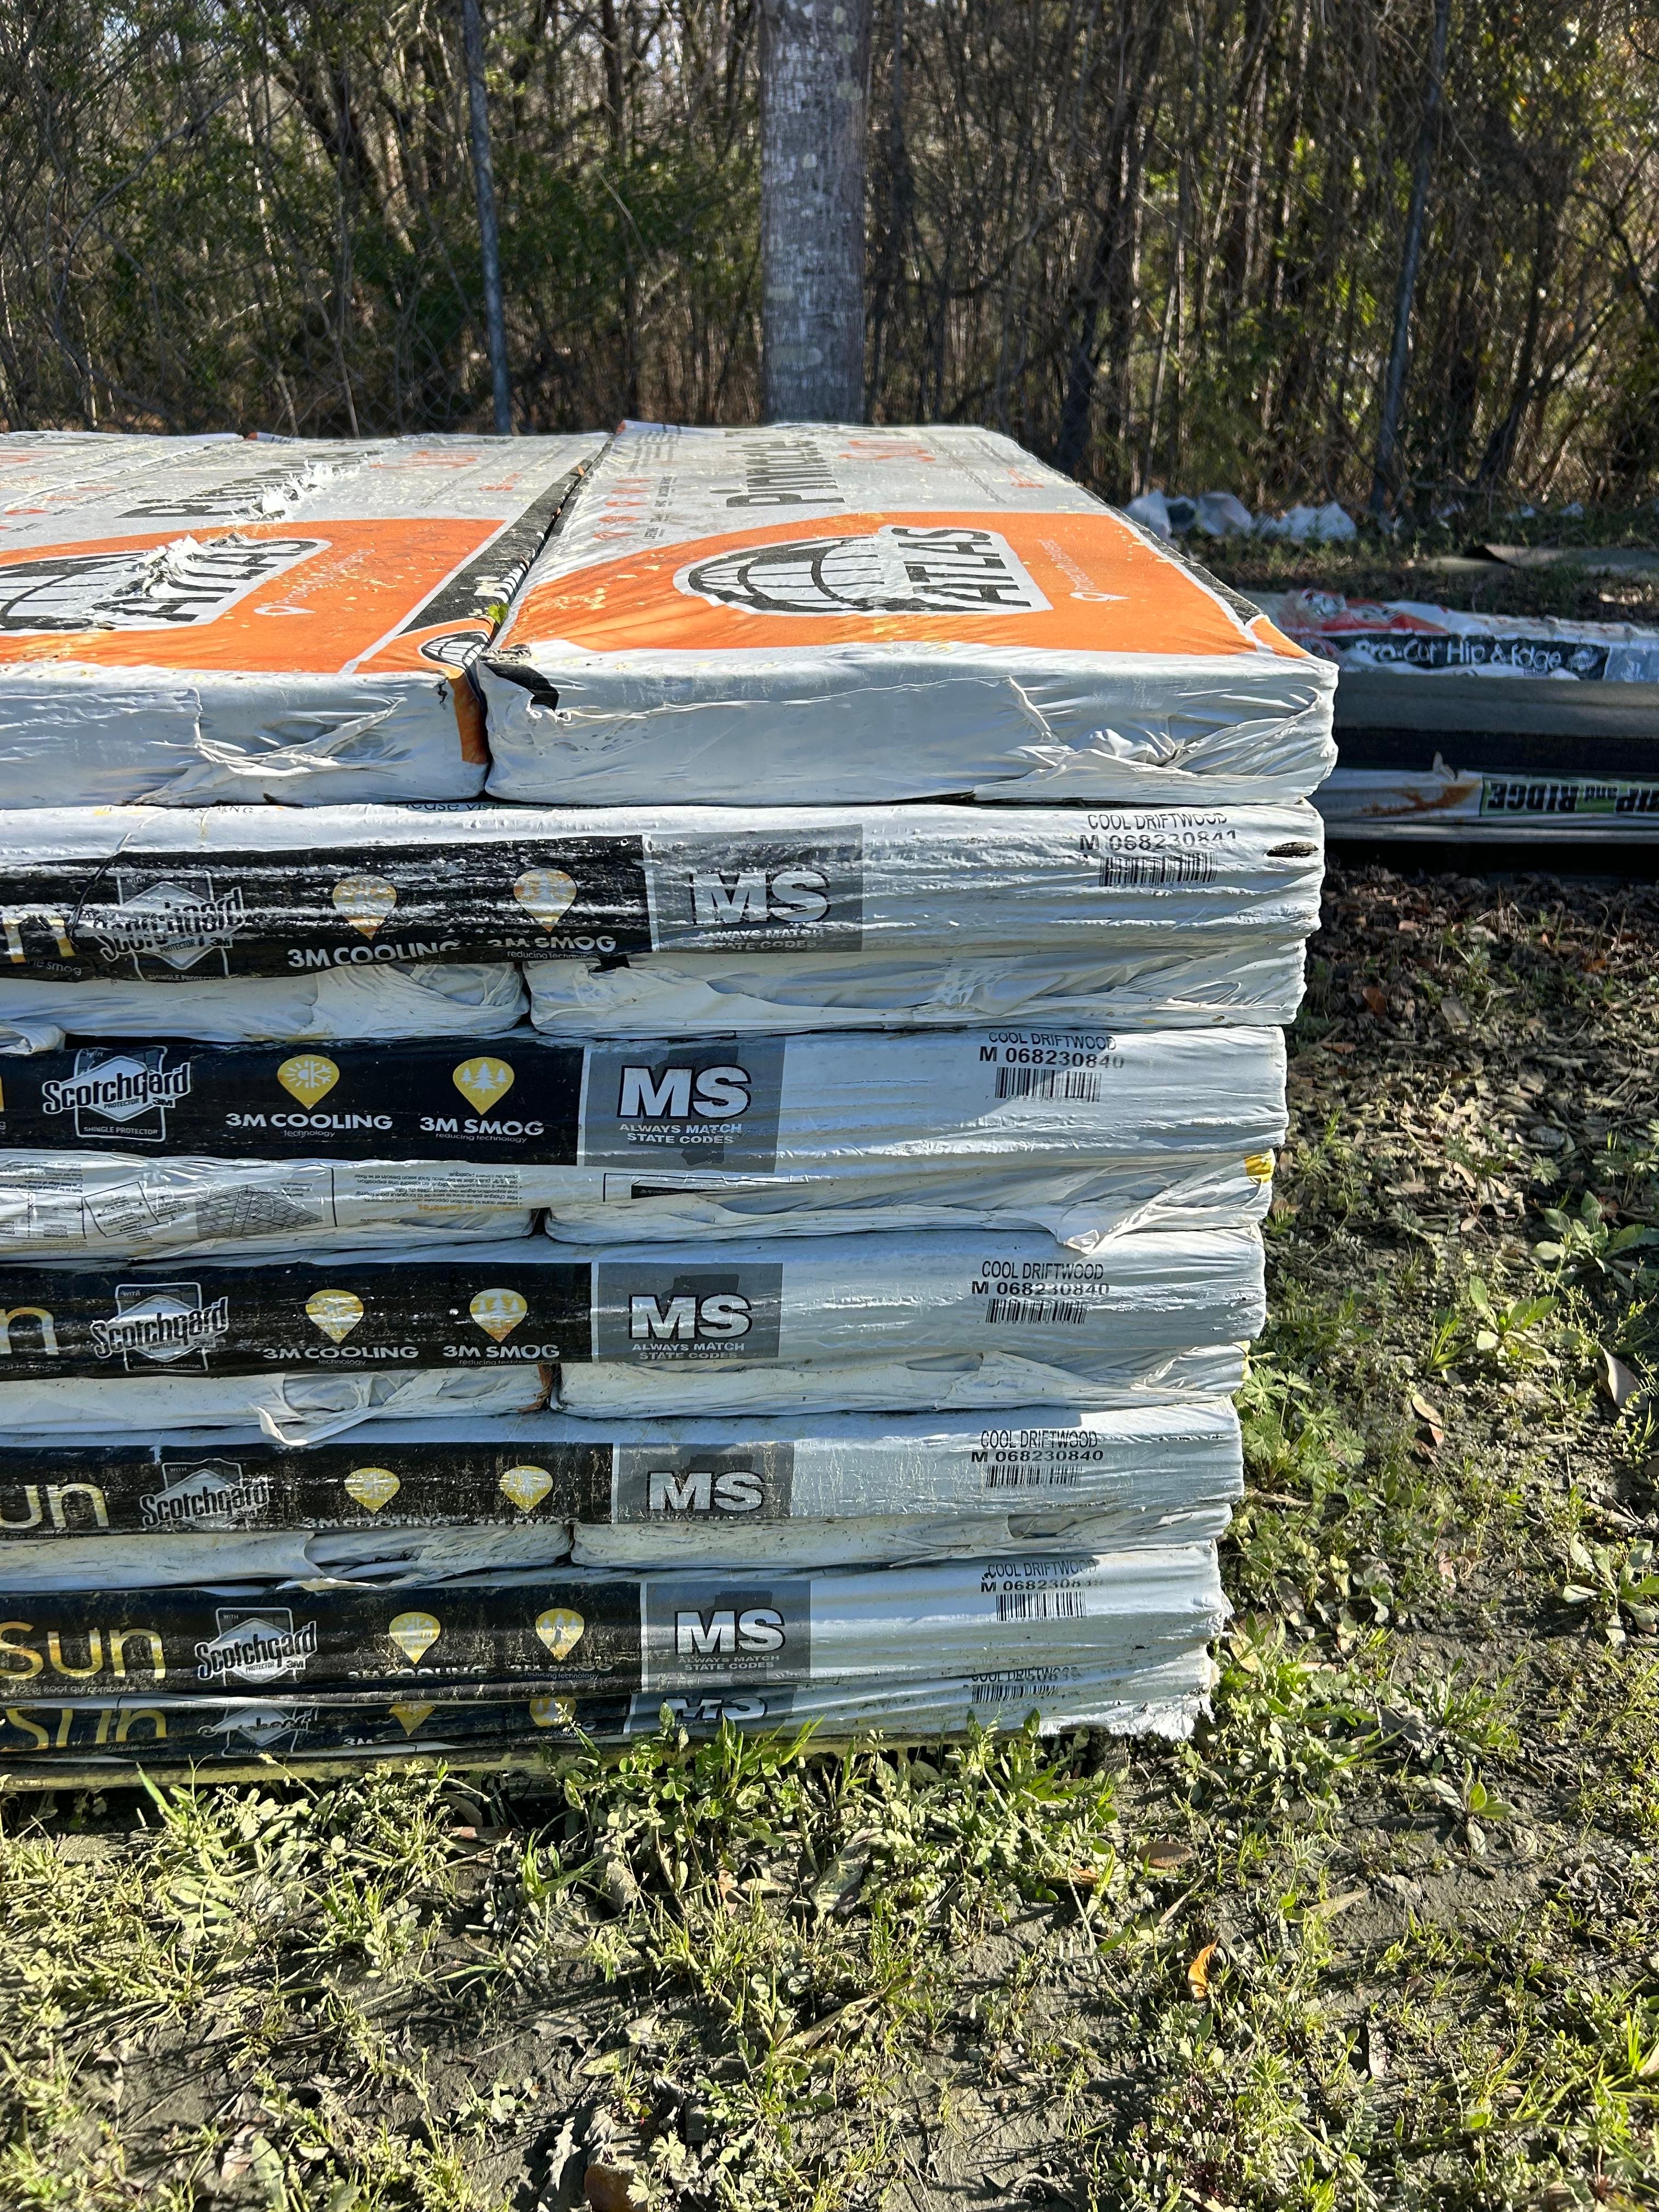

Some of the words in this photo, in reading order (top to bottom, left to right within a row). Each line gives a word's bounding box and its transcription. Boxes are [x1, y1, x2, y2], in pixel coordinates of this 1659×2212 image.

[708, 440, 845, 507] Pinnacle
[891, 527, 1031, 607] ATLAS
[1447, 640, 1486, 665] Hip
[1485, 782, 1578, 812] RIDGE
[1585, 787, 1618, 800] and
[1088, 815, 1131, 830] COOL
[1135, 812, 1227, 830] DRIFTWOOD
[1080, 835, 1099, 850] M
[1109, 830, 1237, 851] 068230841
[689, 867, 831, 926] MS
[211, 936, 233, 947] 3M
[698, 930, 763, 940] ALWAYS
[766, 929, 825, 939] MATCH
[160, 939, 195, 952] PROTECTOR
[538, 936, 616, 952] SMOG
[706, 941, 755, 951] STATE
[760, 940, 817, 950] CODES
[288, 947, 330, 968] 3M
[334, 939, 461, 964] COOLING
[507, 951, 548, 960] reducing
[46, 962, 82, 976] smog
[989, 1032, 1028, 1044] COOL
[1031, 1032, 1117, 1051] DRIFTWOOD
[979, 1046, 997, 1062] M
[1006, 1048, 1125, 1069] 068230840
[43, 1063, 191, 1114] Scotchgard
[617, 1064, 752, 1120] MS
[104, 1098, 139, 1109] PROTECTOR
[153, 1098, 174, 1108] 3M
[225, 1113, 268, 1127] 3M
[270, 1113, 393, 1129] COOLING
[420, 1116, 457, 1132] 3M
[463, 1119, 544, 1136] SMOG
[116, 1127, 158, 1135] PROTECTOR
[284, 1129, 335, 1138] technology
[619, 1123, 681, 1134] ALWAYS
[685, 1123, 743, 1134] MATCH
[435, 1132, 475, 1142] reducing
[476, 1135, 527, 1144] technology
[627, 1133, 675, 1144] STATE
[679, 1134, 735, 1144] CODES
[982, 1261, 1018, 1279] COOL
[1022, 1262, 1104, 1280] DRIFTWOOD
[971, 1282, 988, 1294] M
[997, 1282, 1110, 1296] 068230840
[629, 1292, 753, 1340] MS
[90, 1296, 229, 1359] Scotchgard
[148, 1341, 182, 1351] PROTECTOR
[263, 1348, 301, 1359] 3M
[304, 1347, 419, 1358] COOLING
[443, 1345, 481, 1358] 3M
[486, 1344, 560, 1358] SMOG
[693, 1342, 744, 1351] MATCH
[639, 1352, 684, 1360] STATE
[981, 1430, 1017, 1448] COOL
[1020, 1430, 1097, 1448] DRIFTWOOD
[971, 1452, 989, 1462] M
[995, 1450, 1103, 1462] 068230840
[647, 1470, 765, 1513] MS
[302, 1517, 340, 1528] 3M
[989, 1564, 1021, 1577] COOL
[1024, 1559, 1097, 1576] DRIFTWOOD
[981, 1582, 996, 1592] M
[1003, 1578, 1103, 1591] 0682308
[675, 1607, 786, 1655] MS
[0, 1621, 166, 1680] Sun
[195, 1621, 318, 1680] Scotchgard
[286, 1660, 303, 1669] 3M
[731, 1655, 780, 1663] MATCH
[246, 1661, 274, 1672] PROTECTOR
[524, 1672, 557, 1680] reducing
[558, 1672, 599, 1680] technology
